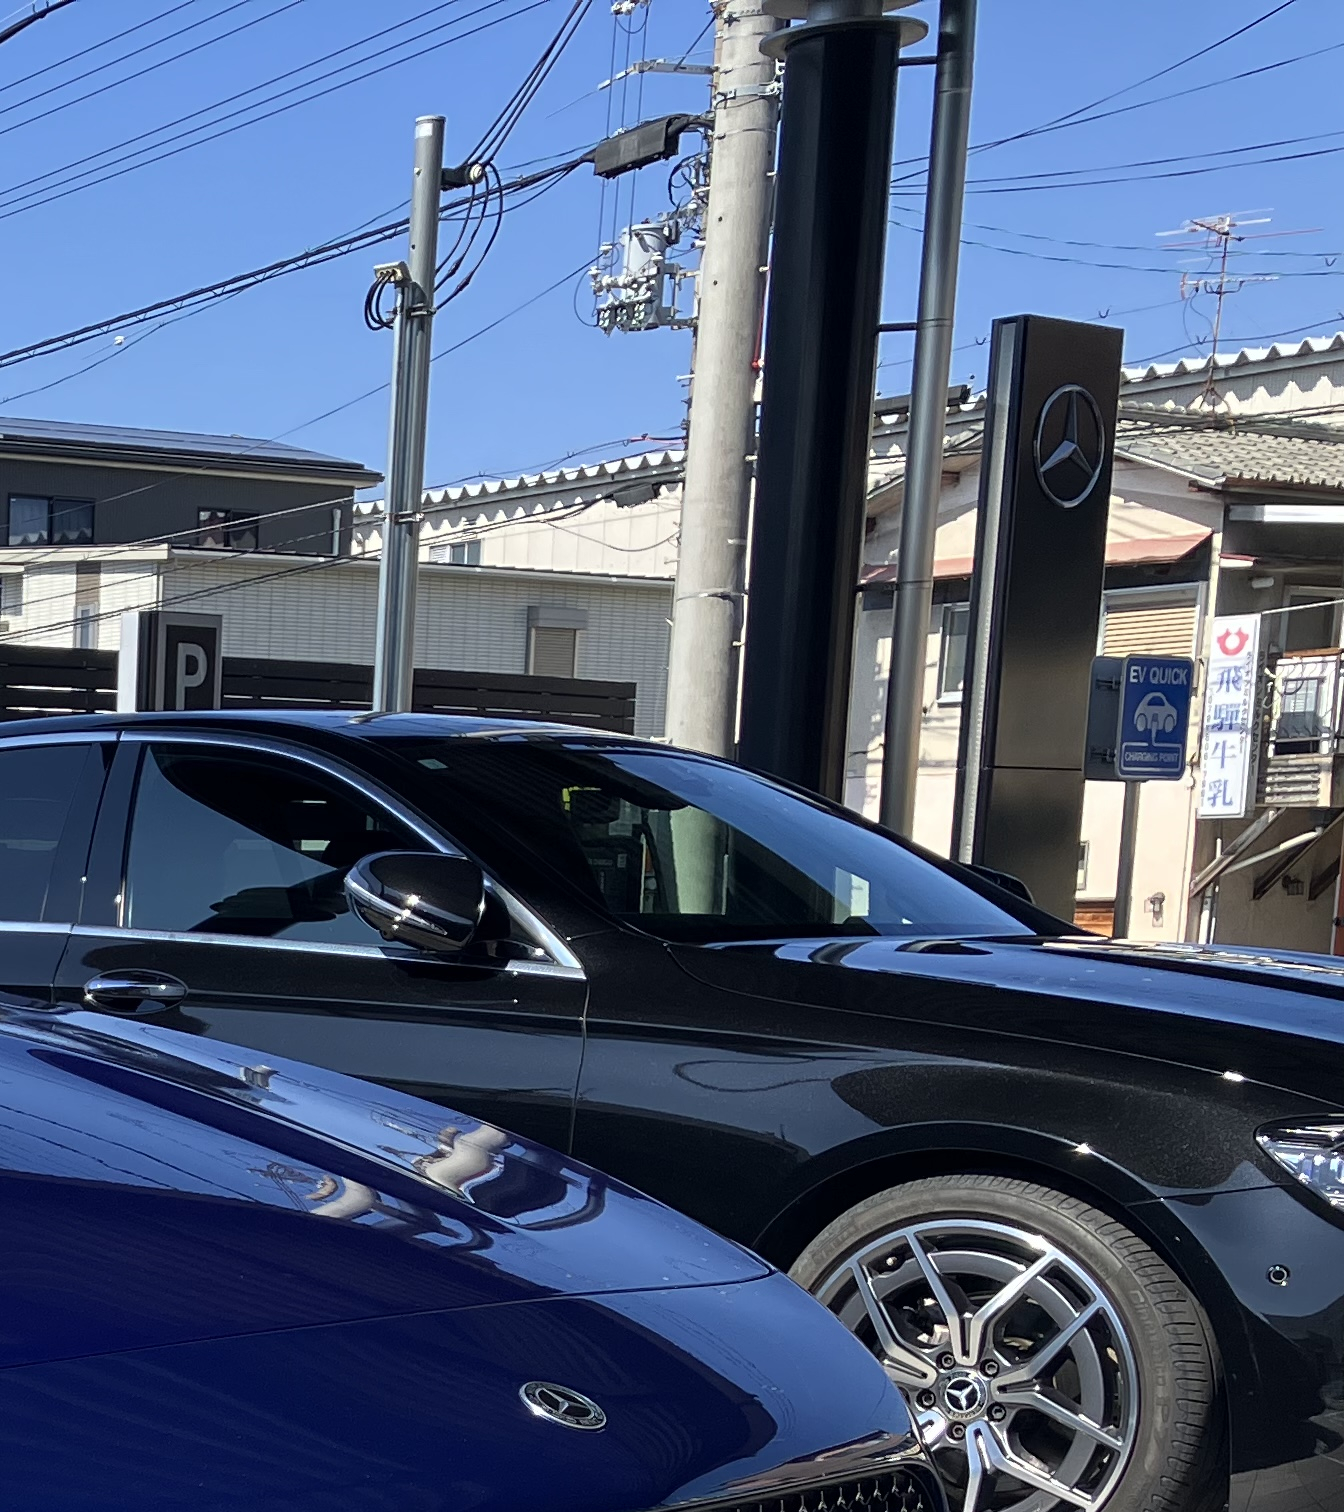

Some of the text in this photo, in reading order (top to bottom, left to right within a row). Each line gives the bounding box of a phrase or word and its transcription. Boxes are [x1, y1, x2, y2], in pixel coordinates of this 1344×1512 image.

[176, 642, 208, 711] P
[1129, 665, 1188, 685] EV QUICK
[1124, 751, 1179, 763] CHARGING POINT
